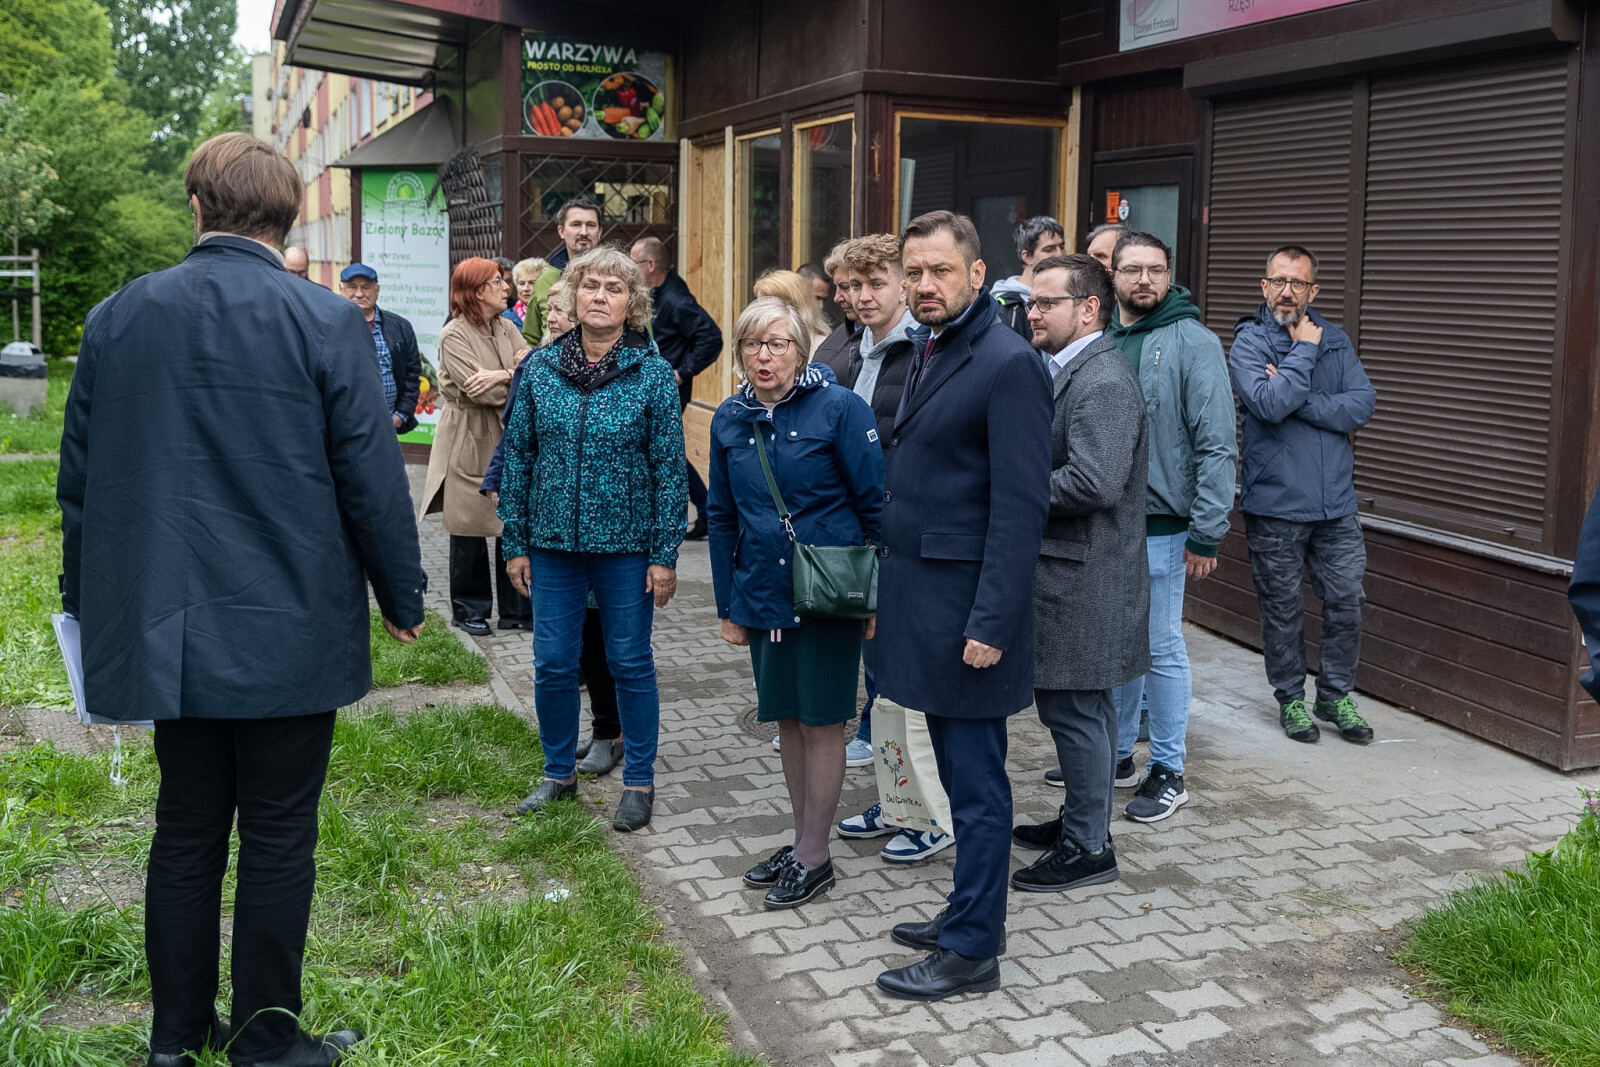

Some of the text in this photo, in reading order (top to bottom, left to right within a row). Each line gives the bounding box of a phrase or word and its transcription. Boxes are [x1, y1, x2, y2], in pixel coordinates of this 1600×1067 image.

[524, 39, 637, 65] WARZYWA
[526, 61, 613, 74] PROSTO OD ROLNIKA
[365, 221, 445, 238] Zielony Bazar
